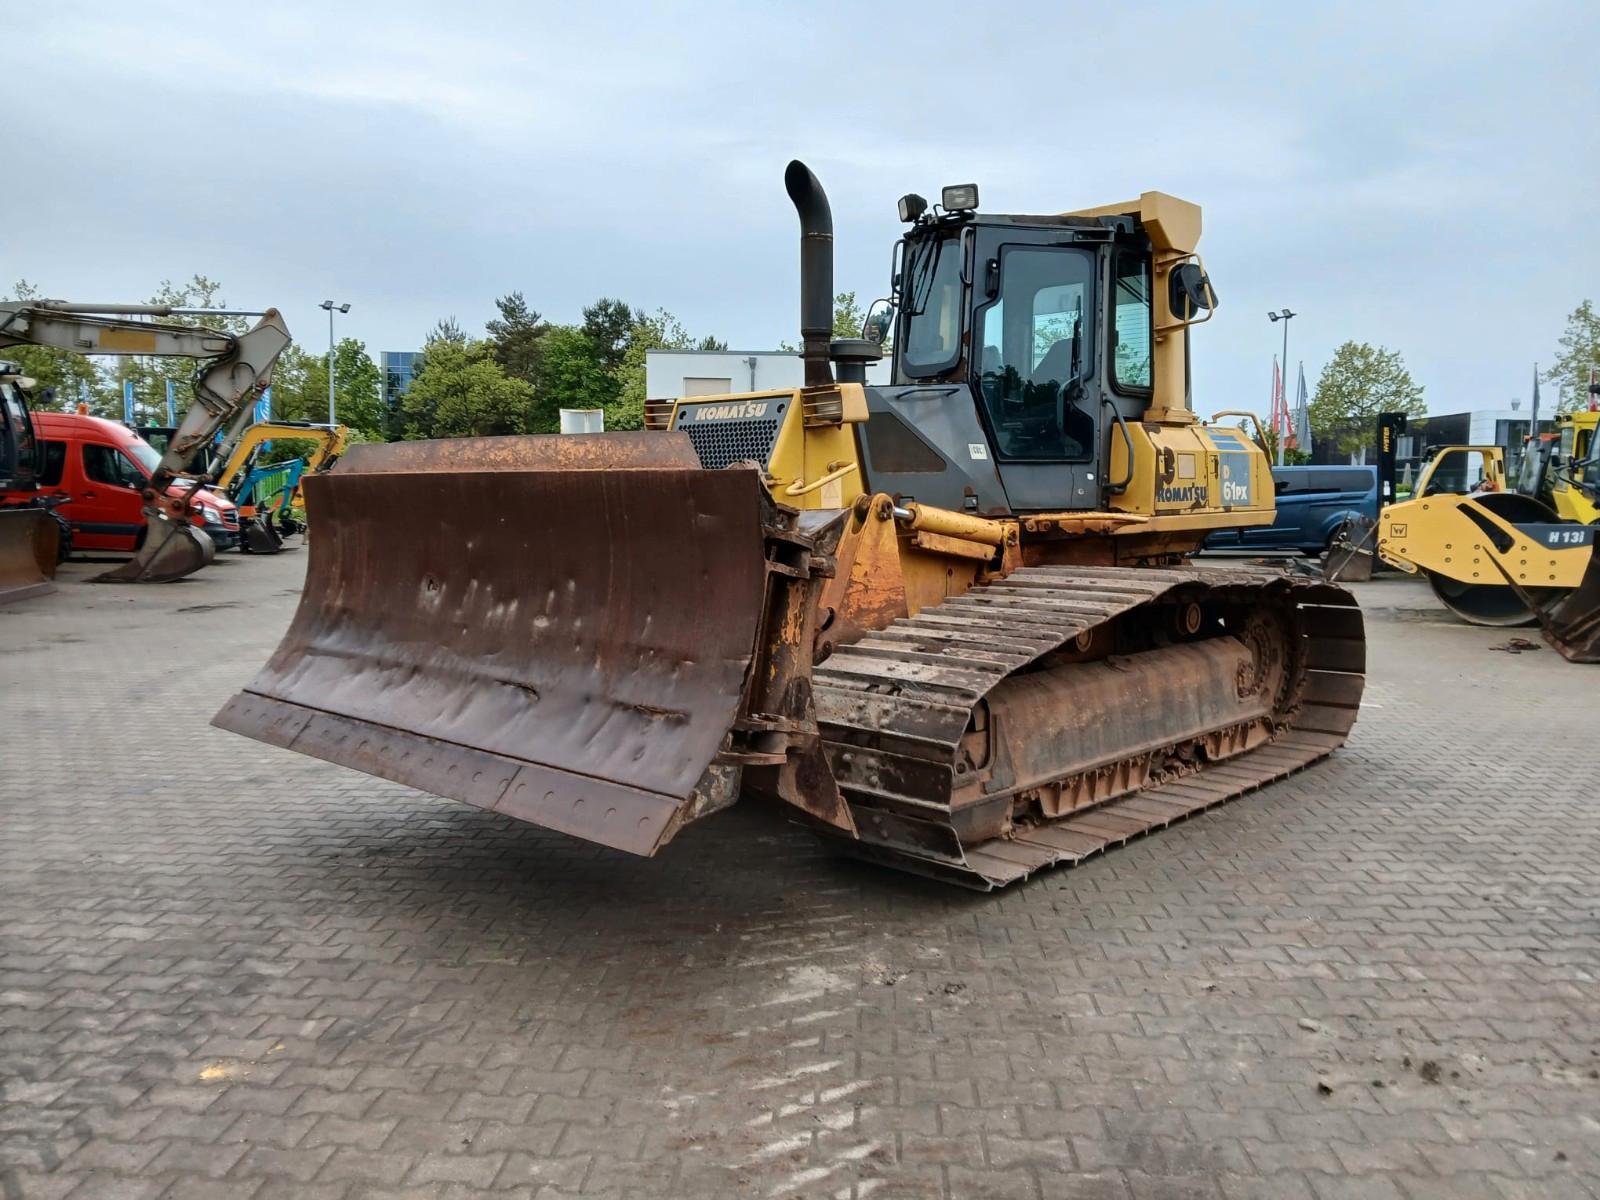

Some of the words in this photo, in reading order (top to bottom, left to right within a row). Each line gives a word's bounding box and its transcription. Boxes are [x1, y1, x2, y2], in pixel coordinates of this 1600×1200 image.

[695, 401, 768, 421] KOMATSU
[1223, 464, 1230, 480] D
[1157, 483, 1207, 503] KOMATSU
[1223, 481, 1248, 501] 61PX
[1549, 531, 1560, 543] H
[1562, 530, 1585, 543] 13i
